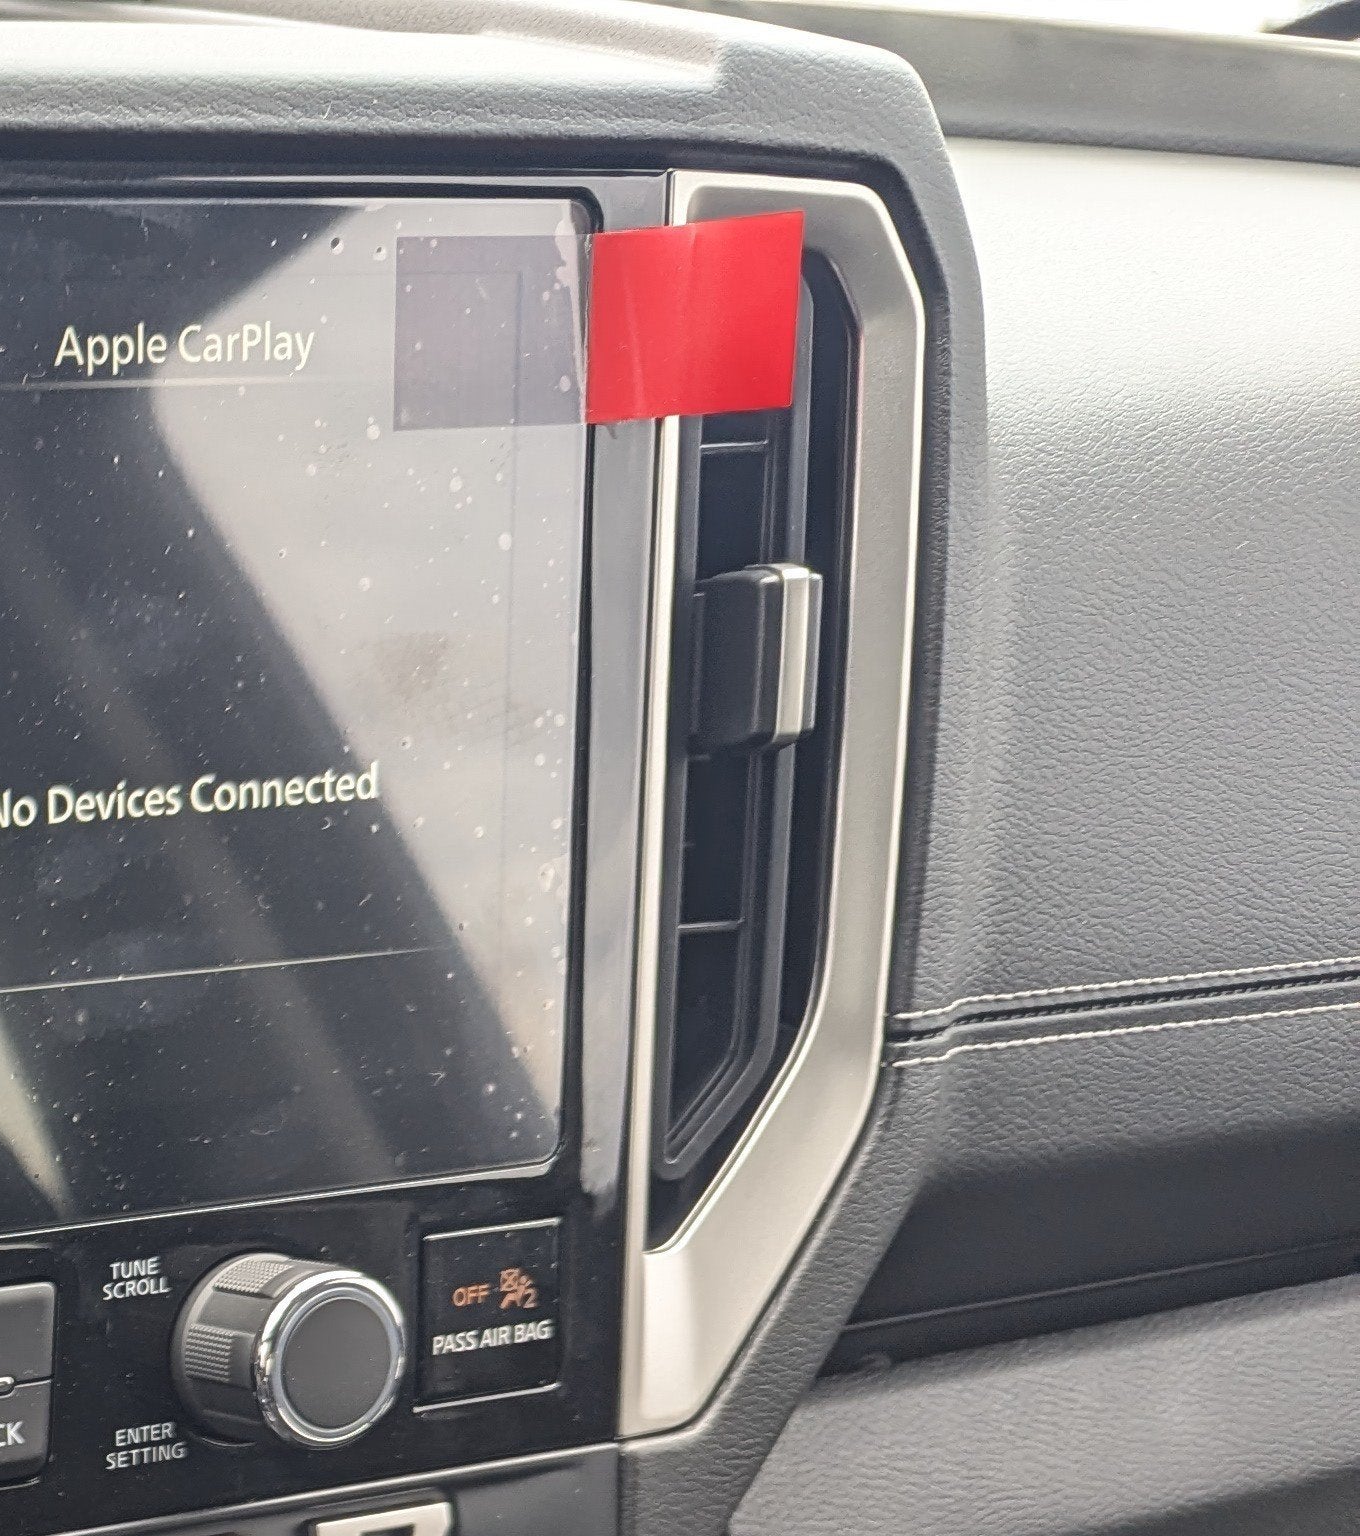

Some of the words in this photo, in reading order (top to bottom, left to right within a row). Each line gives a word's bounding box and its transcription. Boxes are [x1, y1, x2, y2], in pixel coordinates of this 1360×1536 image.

[53, 322, 168, 369] Apple
[177, 318, 316, 364] CarPlay
[47, 776, 179, 821] Devices
[190, 762, 379, 812] Connected
[109, 1256, 159, 1280] TUNE
[102, 1275, 171, 1301] SCROLL
[452, 1283, 491, 1308] OFF
[432, 1328, 478, 1356] PASS
[480, 1325, 511, 1349] AIR
[513, 1319, 553, 1344] BAG
[114, 1422, 174, 1448] ENTER
[104, 1441, 188, 1470] SETTING
